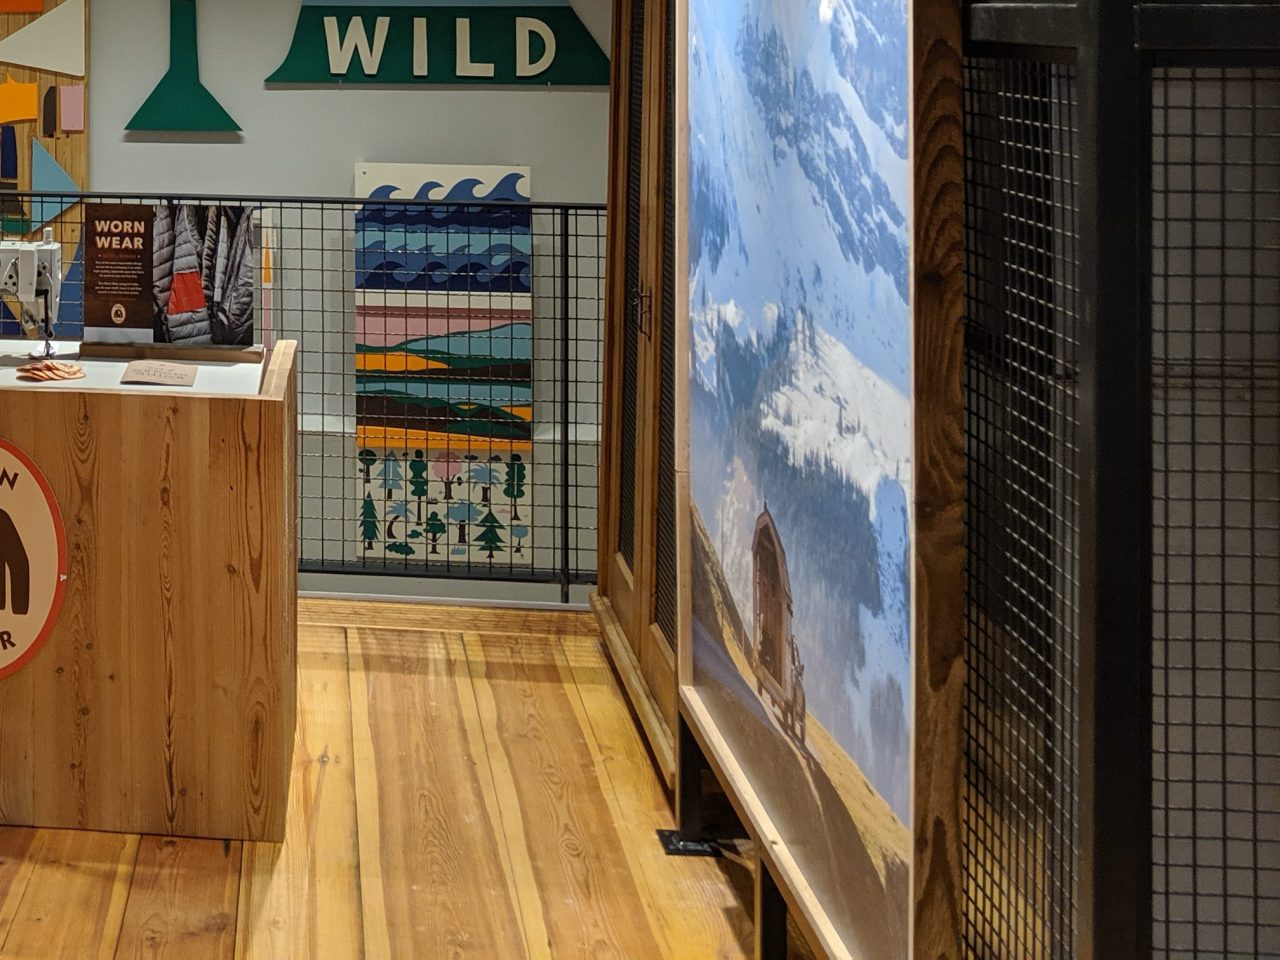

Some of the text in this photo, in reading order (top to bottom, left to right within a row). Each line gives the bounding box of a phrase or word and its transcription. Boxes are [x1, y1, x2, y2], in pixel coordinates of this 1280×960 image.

[322, 15, 557, 78] WILD
[95, 220, 145, 234] WORN
[96, 236, 144, 250] WEAR
